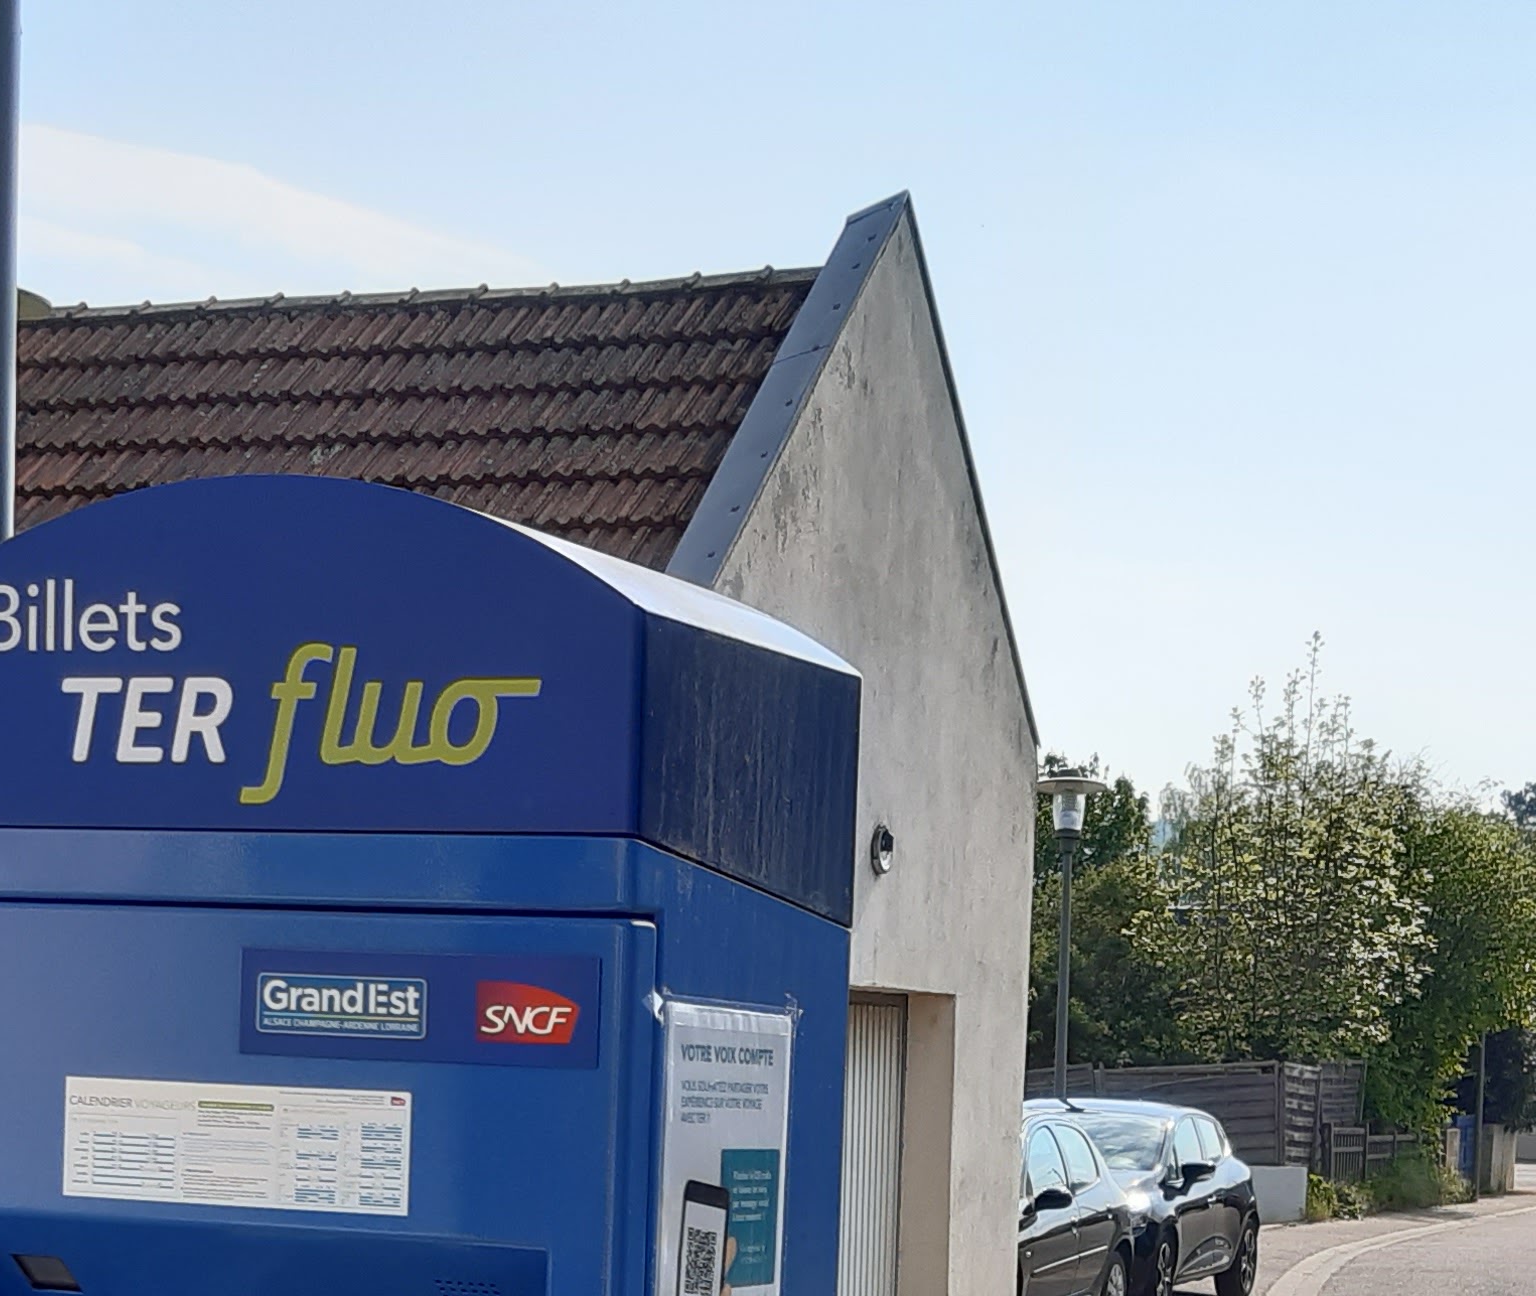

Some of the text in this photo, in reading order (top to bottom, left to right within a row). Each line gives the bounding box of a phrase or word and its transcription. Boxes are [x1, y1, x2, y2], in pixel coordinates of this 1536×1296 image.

[60, 641, 543, 805] TER fluo
[263, 978, 420, 1016] Grand Est
[480, 1004, 573, 1035] SNCF
[680, 1043, 775, 1067] VOTRE VOIX COMPTE
[69, 1094, 134, 1109] CALENDRIER
